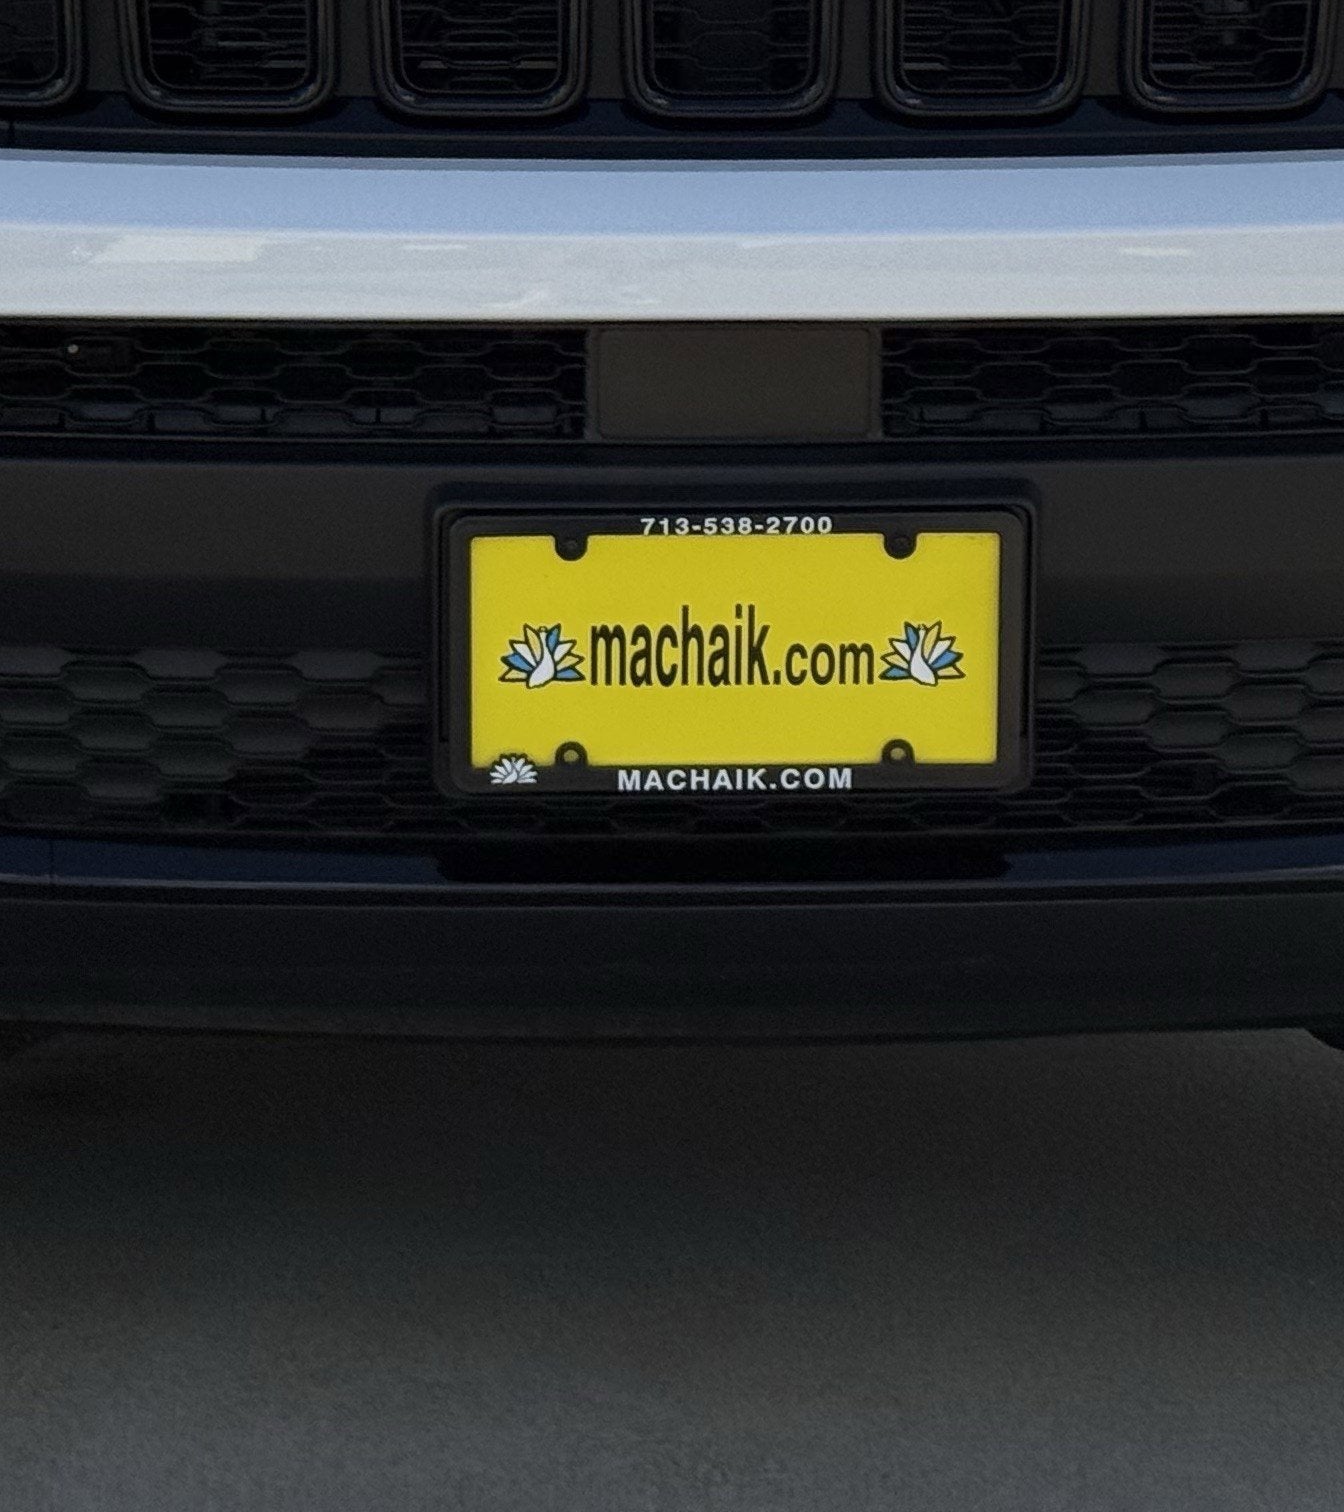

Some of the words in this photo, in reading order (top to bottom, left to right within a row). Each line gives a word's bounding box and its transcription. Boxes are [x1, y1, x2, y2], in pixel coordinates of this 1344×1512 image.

[641, 516, 833, 536] 713-538-2700
[590, 604, 875, 686] machaik.com
[617, 768, 853, 791] MACHAIK.COM
